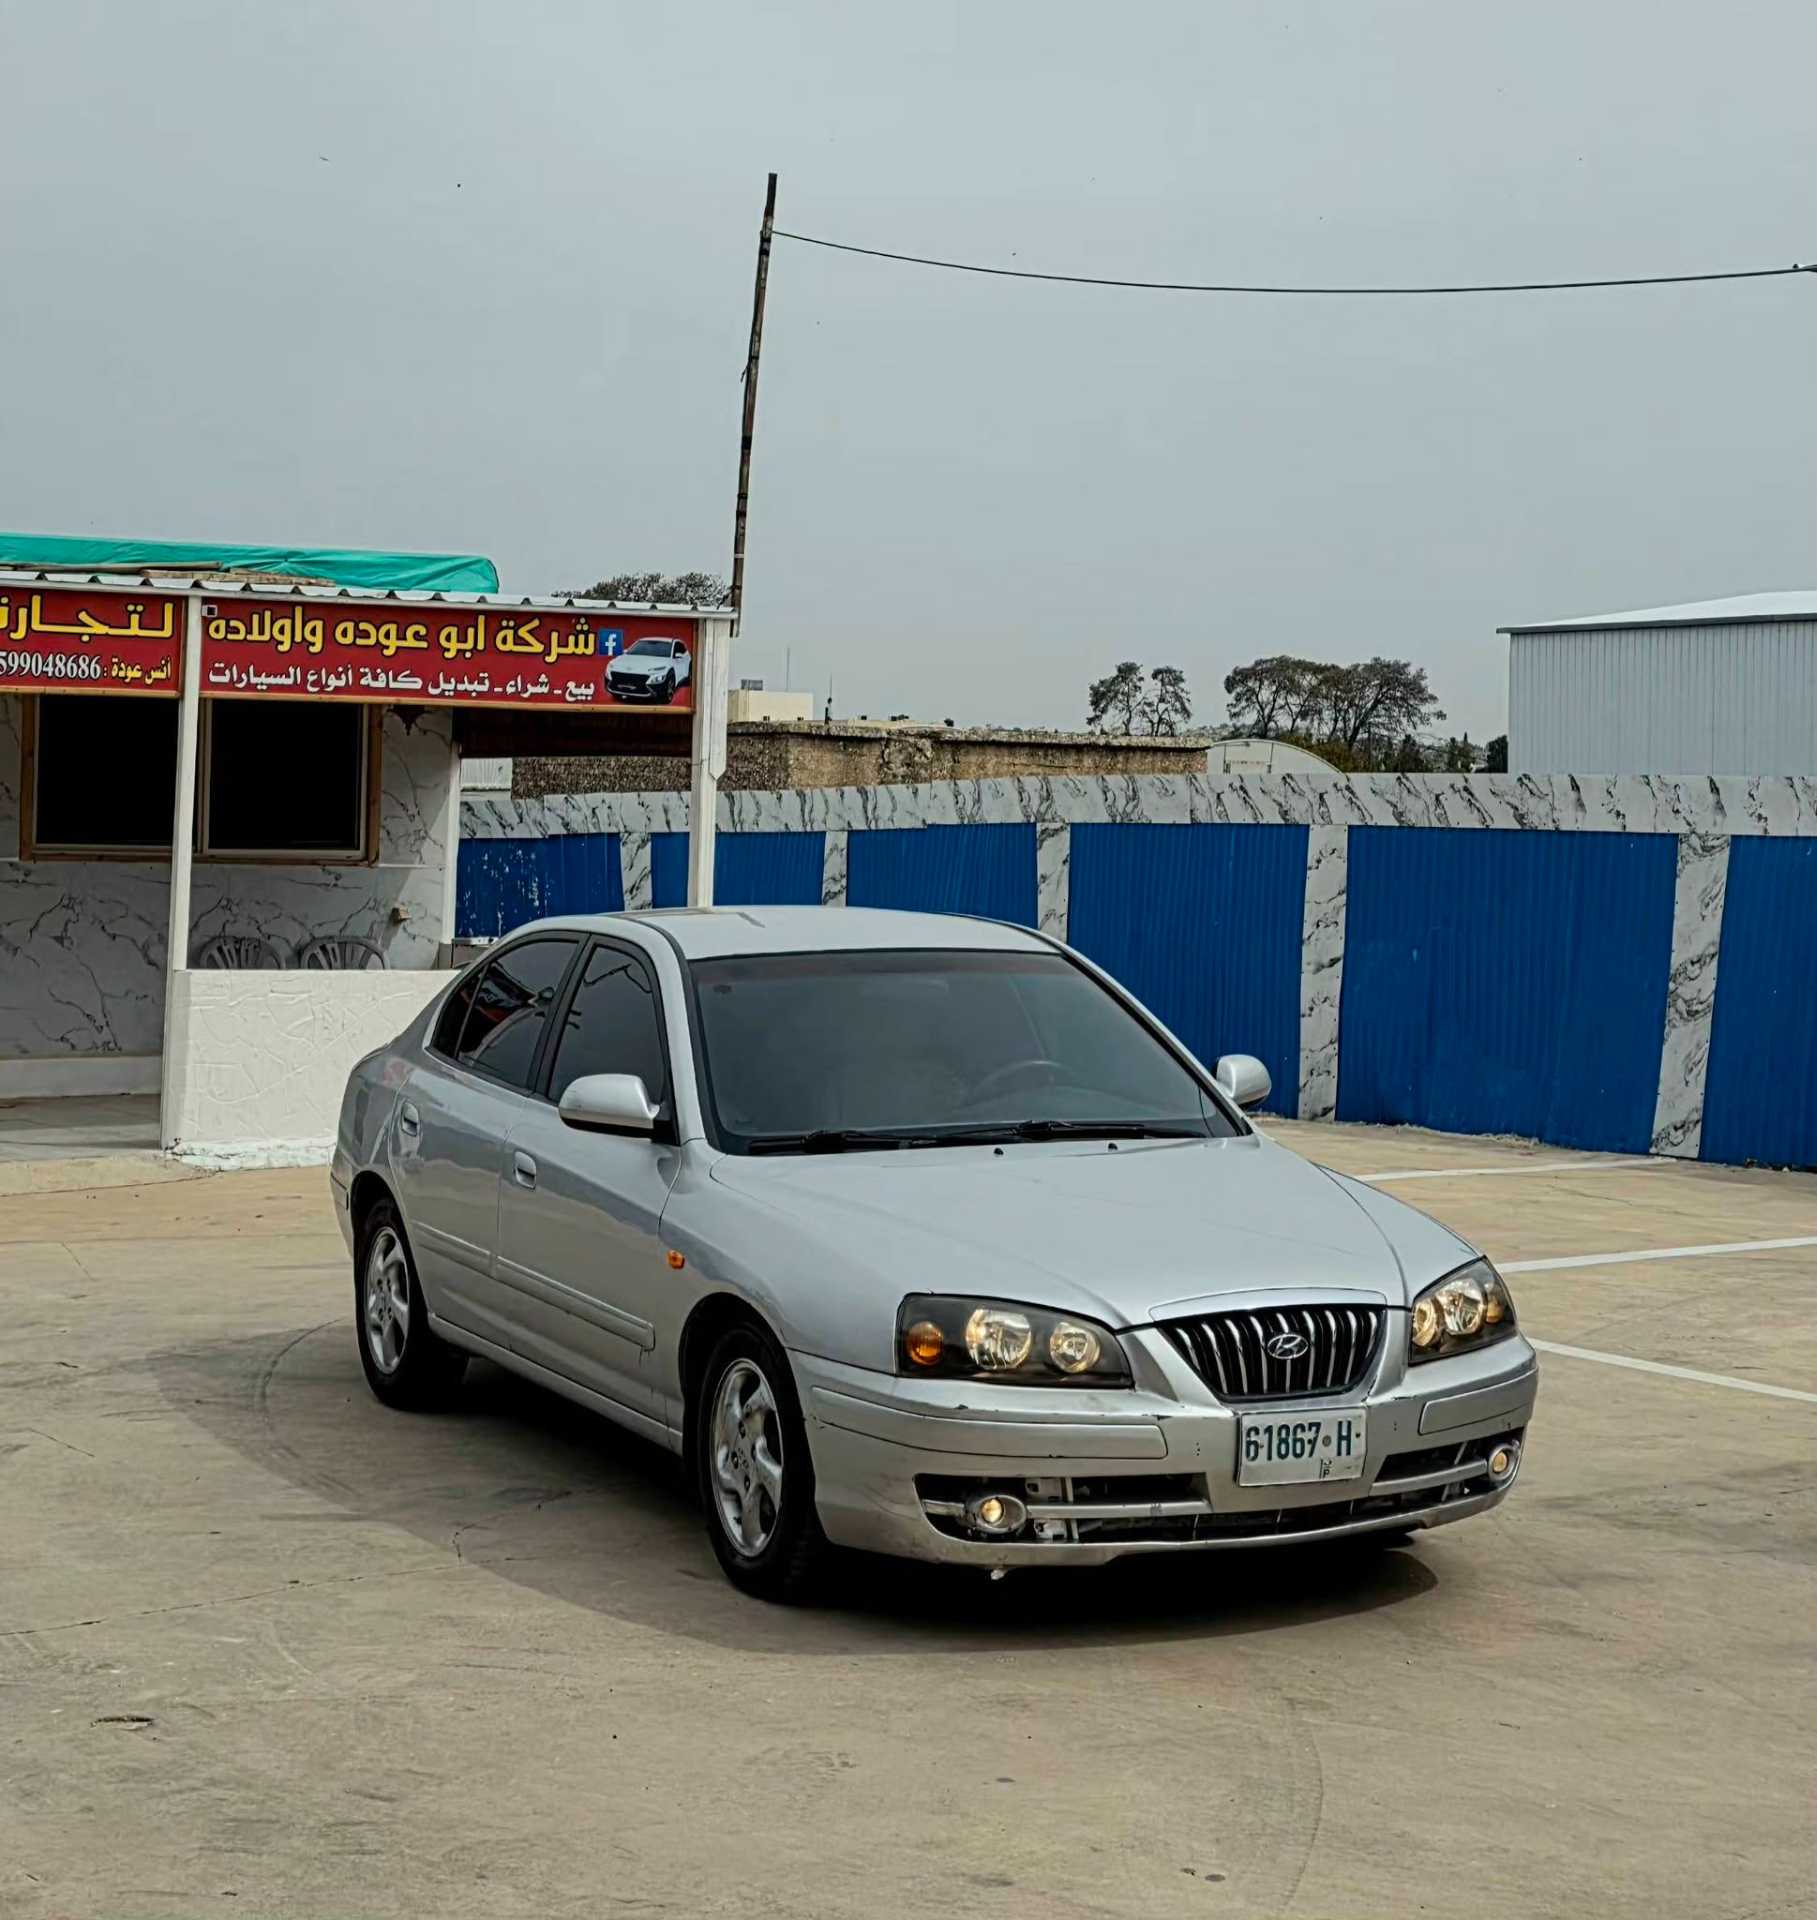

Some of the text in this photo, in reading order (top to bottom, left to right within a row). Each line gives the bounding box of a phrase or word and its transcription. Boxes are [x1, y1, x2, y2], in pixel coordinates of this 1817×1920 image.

[208, 606, 595, 663] شركة ابو عوده واولاده
[209, 662, 301, 690] السيارات
[306, 664, 353, 692] أنواع
[359, 667, 423, 690] كافة
[427, 671, 490, 697] تبديل
[505, 673, 550, 698] شراء
[565, 680, 595, 702] بيع
[1337, 1420, 1352, 1457] H
